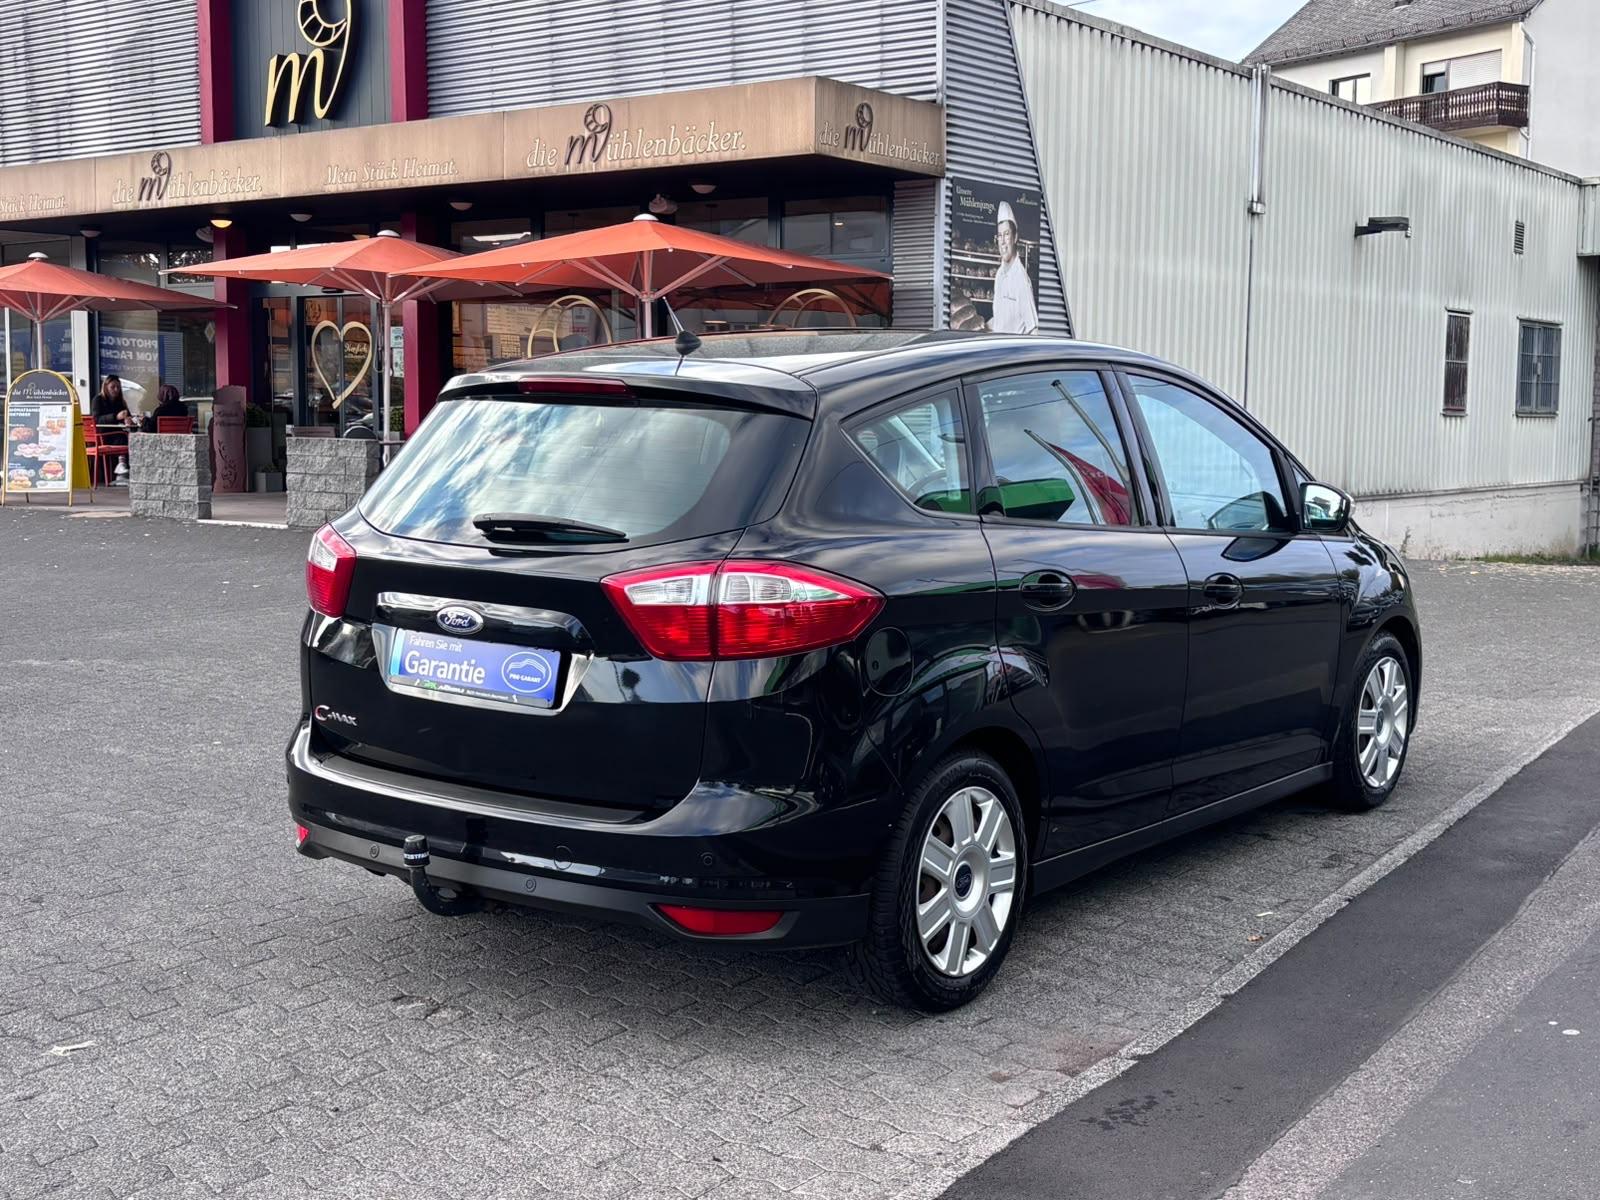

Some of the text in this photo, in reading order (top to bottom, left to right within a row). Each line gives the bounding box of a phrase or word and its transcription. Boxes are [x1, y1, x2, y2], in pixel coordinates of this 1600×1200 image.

[819, 122, 840, 146] die
[526, 138, 557, 168] die
[323, 164, 357, 185] Mein
[362, 160, 399, 183] Stück
[112, 178, 134, 204] die
[444, 610, 470, 627] Ford
[408, 635, 462, 652] Fahren Sie mit
[404, 650, 486, 684] Garantie
